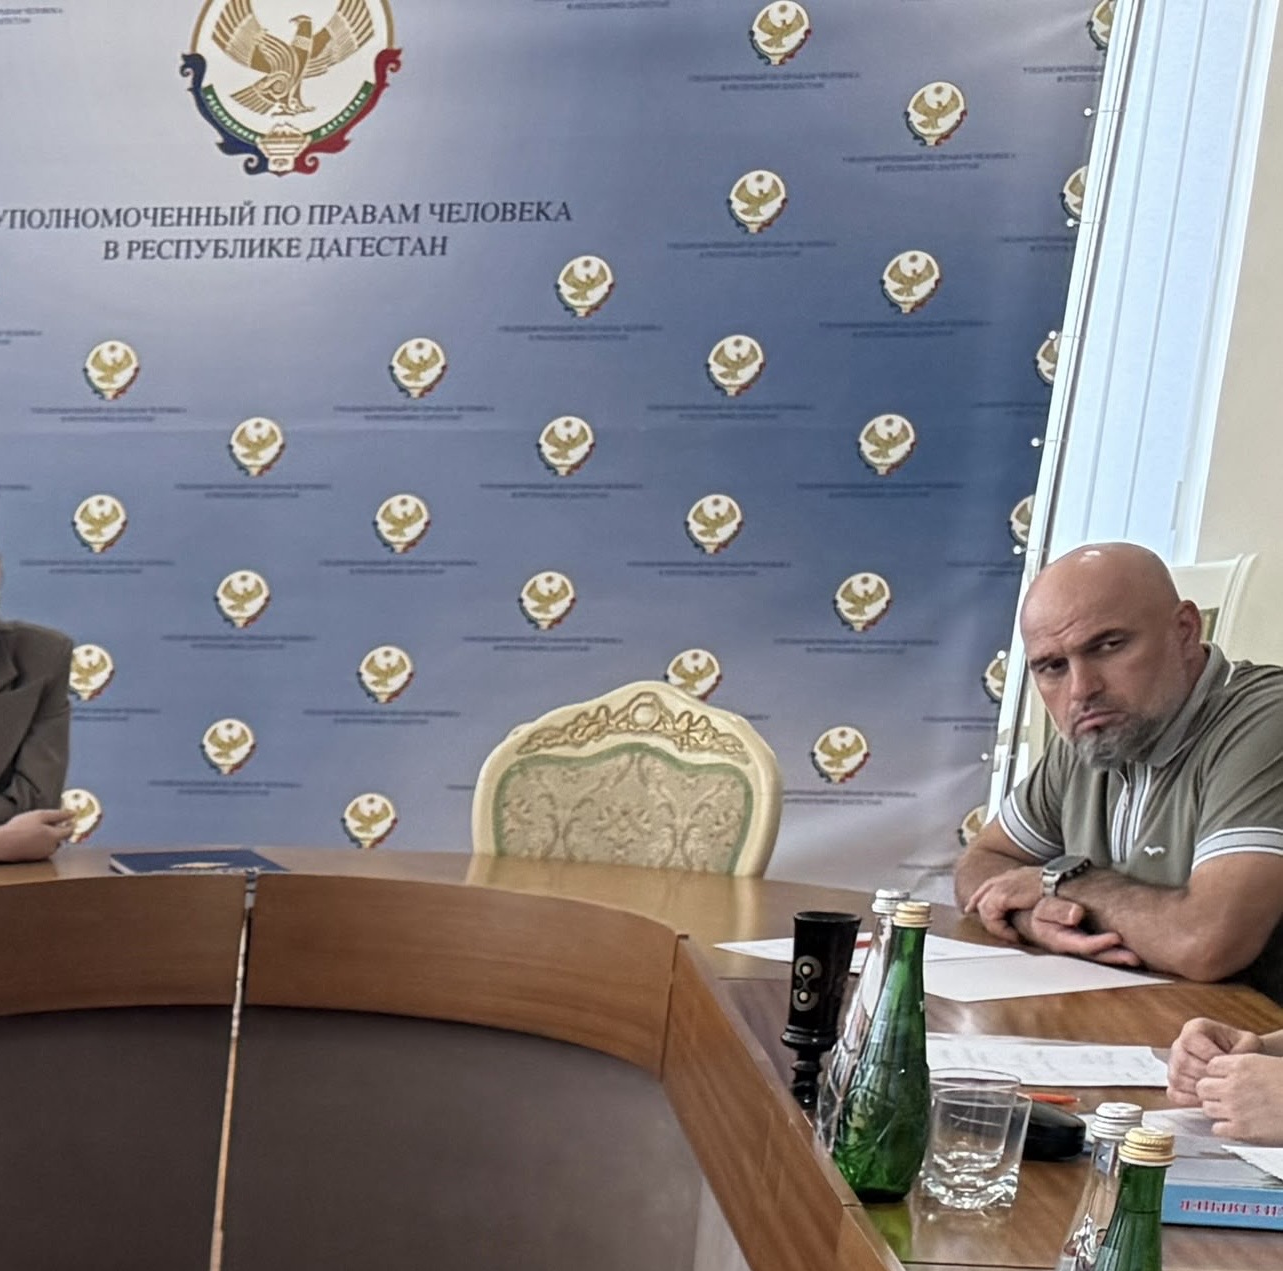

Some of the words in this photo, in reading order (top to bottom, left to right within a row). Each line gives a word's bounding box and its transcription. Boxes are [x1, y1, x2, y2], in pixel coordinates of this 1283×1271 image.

[263, 204, 301, 227] ПО
[307, 203, 421, 226] ПРАВАМ
[428, 201, 573, 224] ЧЕЛОВЕКА
[103, 239, 120, 261] В
[126, 237, 301, 260] РЕСПУБЛИКЕ
[306, 235, 449, 262] ДАГЕСТАН
